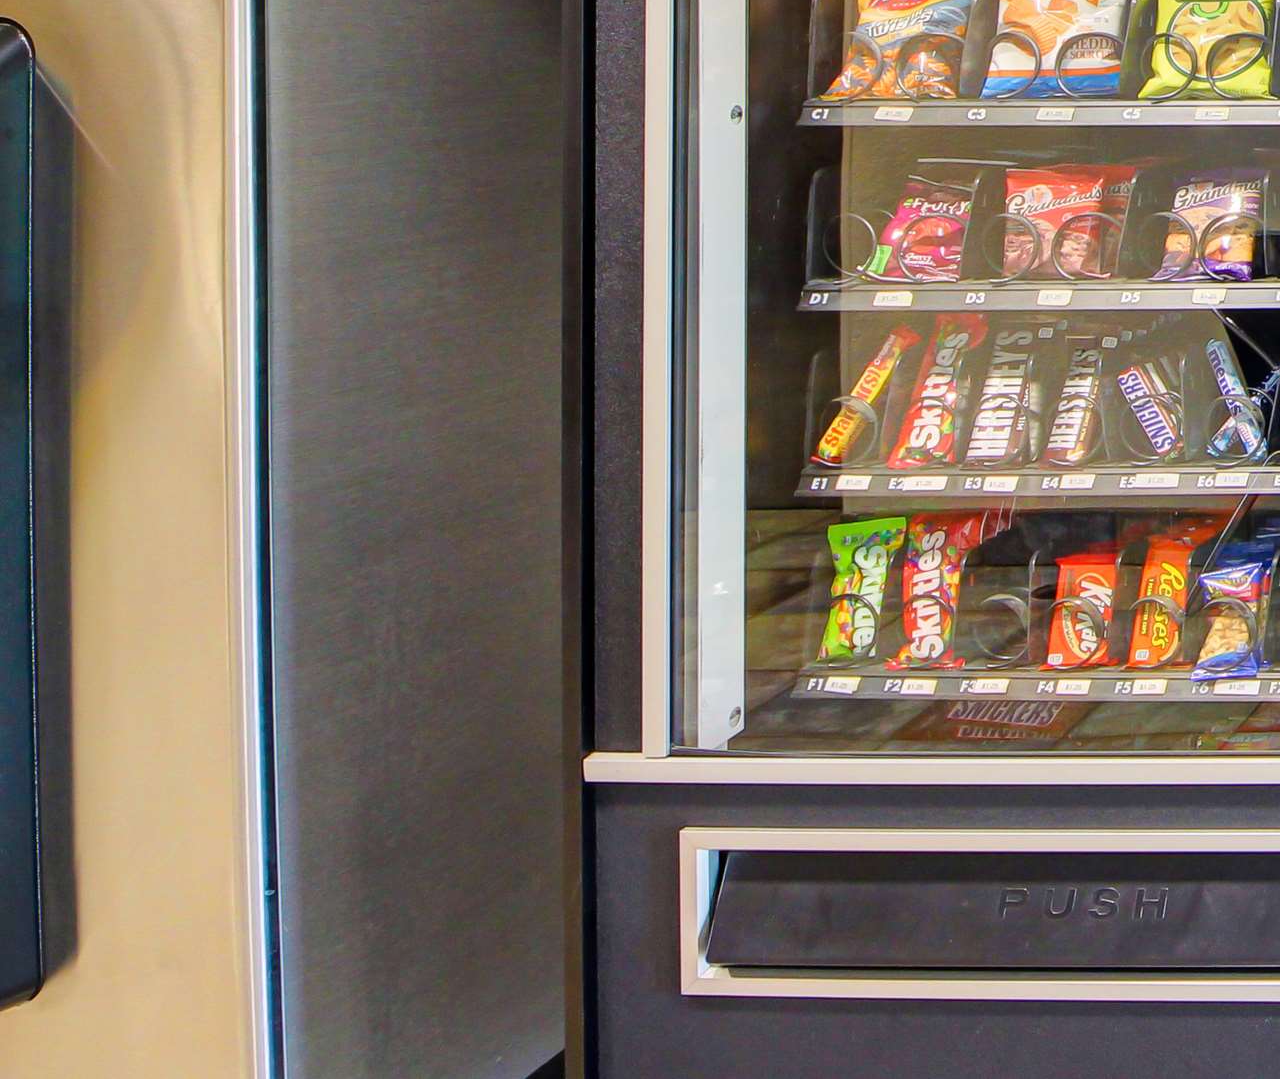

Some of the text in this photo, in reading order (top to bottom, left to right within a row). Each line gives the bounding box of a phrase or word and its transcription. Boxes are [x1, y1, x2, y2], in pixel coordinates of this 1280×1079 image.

[812, 108, 830, 119] C1
[967, 108, 986, 120] C3
[1122, 108, 1142, 120] C5
[809, 293, 830, 304] D1
[965, 292, 986, 304] D3
[1120, 292, 1142, 303] D5
[966, 330, 1033, 461] HERSHEY'S
[1048, 347, 1099, 450] HERSHEY'S
[811, 478, 829, 490] E1
[888, 478, 905, 490] E2
[964, 477, 982, 490] E3
[1042, 476, 1060, 490] E4
[1119, 476, 1136, 489] E5
[1196, 476, 1214, 488] E6
[909, 529, 946, 659] Skittles
[807, 678, 824, 691] F1
[884, 679, 902, 692] F2
[960, 680, 976, 692] F3
[1036, 681, 1055, 694] F4
[1114, 681, 1132, 694] F5
[1192, 682, 1210, 694] F6
[999, 886, 1169, 921] PUSH
